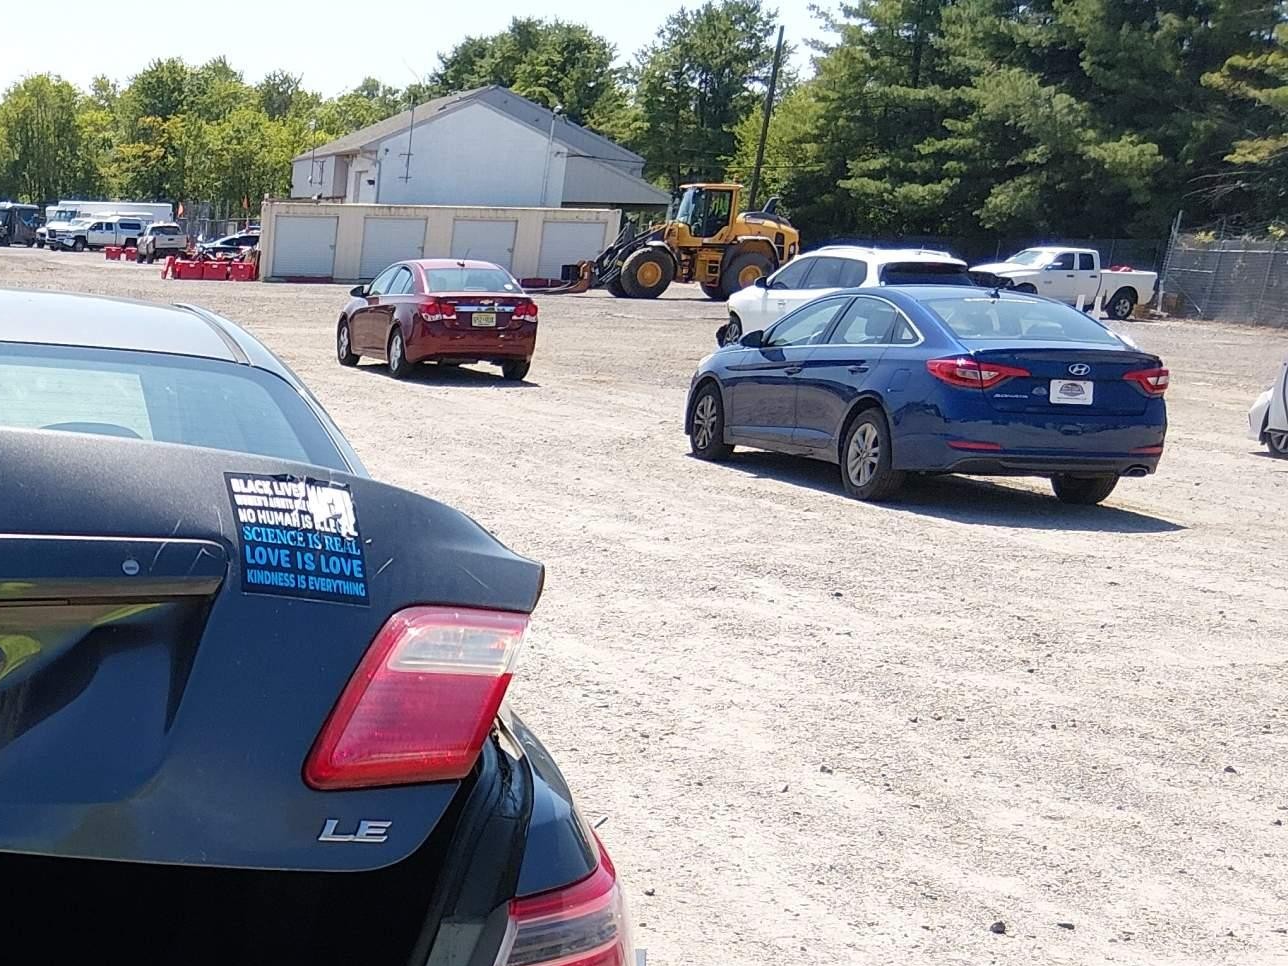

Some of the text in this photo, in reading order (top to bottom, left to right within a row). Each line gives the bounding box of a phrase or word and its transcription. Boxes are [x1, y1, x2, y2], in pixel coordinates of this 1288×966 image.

[230, 478, 273, 495] BLACK
[237, 507, 256, 523] NO
[256, 509, 300, 528] HUMAN
[300, 514, 313, 530] IS
[242, 525, 361, 556] SCIENCE IS REAL
[245, 543, 364, 578] LOVE IS LOVE
[246, 568, 366, 597] KINDNESS IS EVERYTHING
[318, 819, 392, 842] LE
